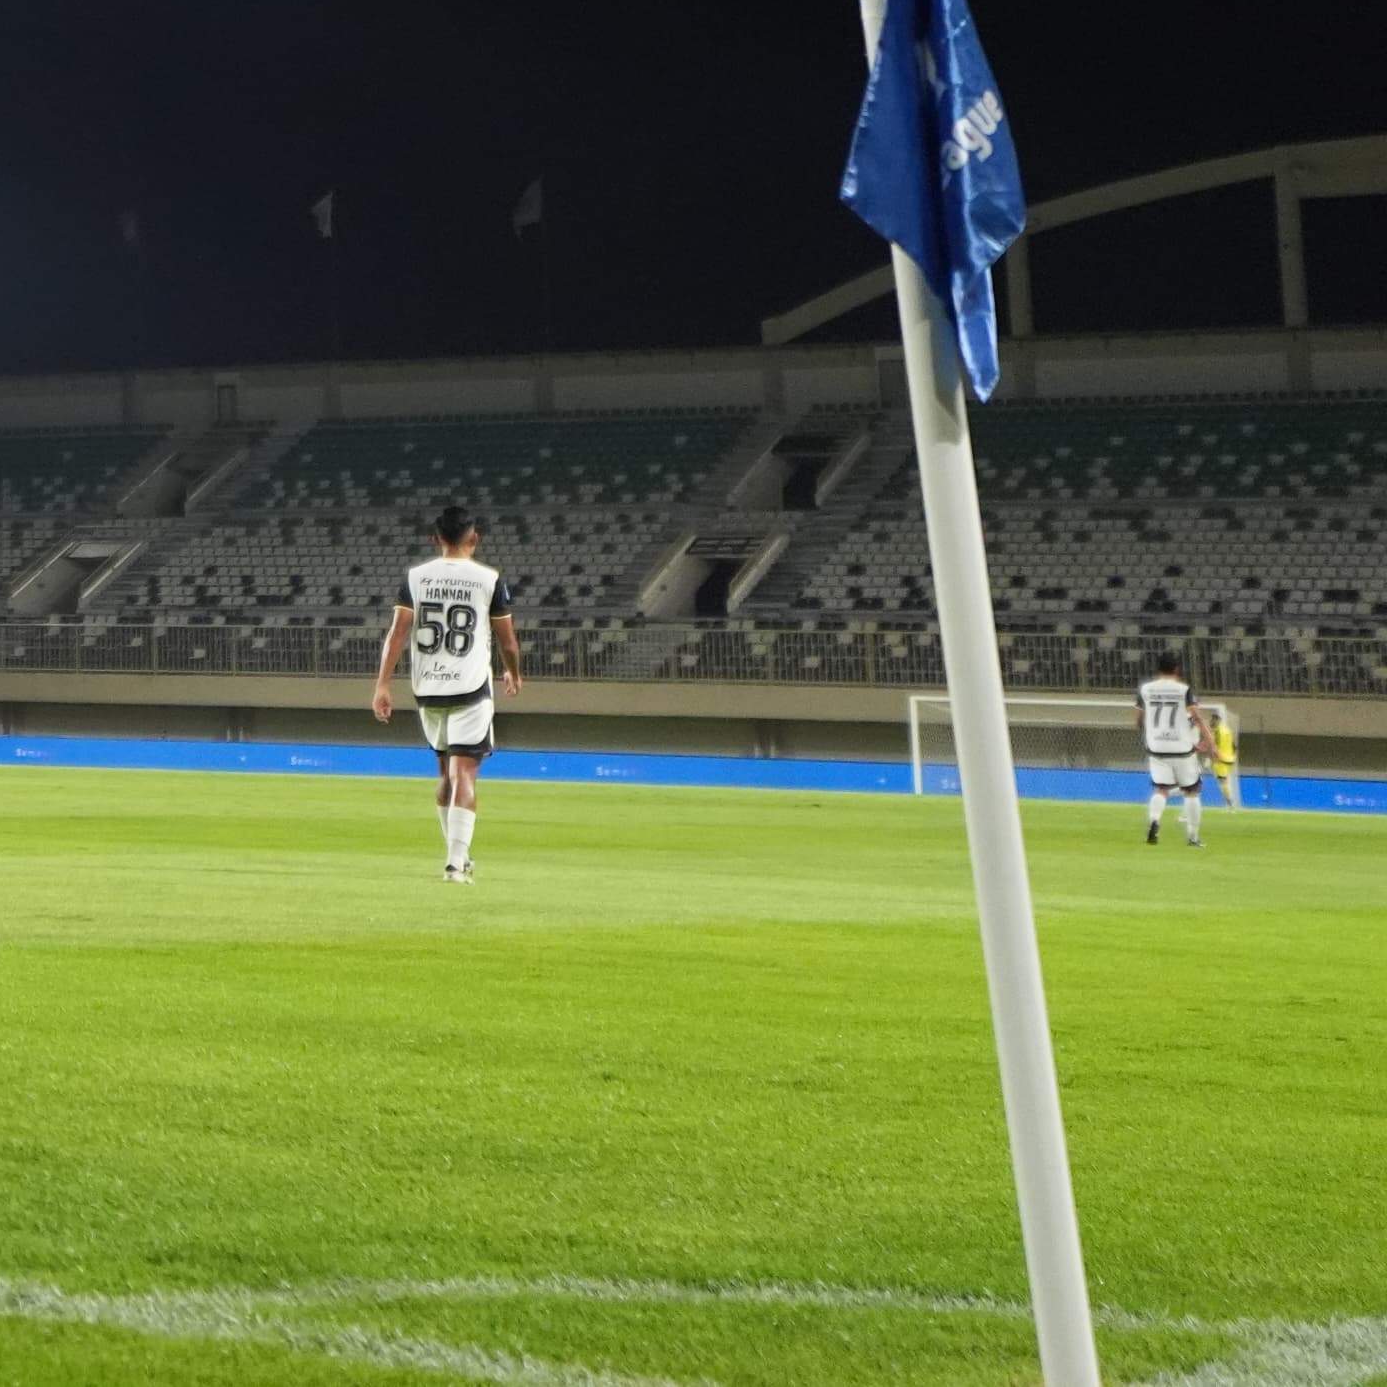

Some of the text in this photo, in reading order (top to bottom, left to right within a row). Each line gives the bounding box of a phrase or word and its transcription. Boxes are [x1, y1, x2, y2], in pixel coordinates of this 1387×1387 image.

[942, 90, 1003, 172] ague
[425, 588, 472, 602] HANNAN
[417, 601, 477, 657] 58
[433, 661, 445, 672] Le
[1149, 701, 1179, 729] 77
